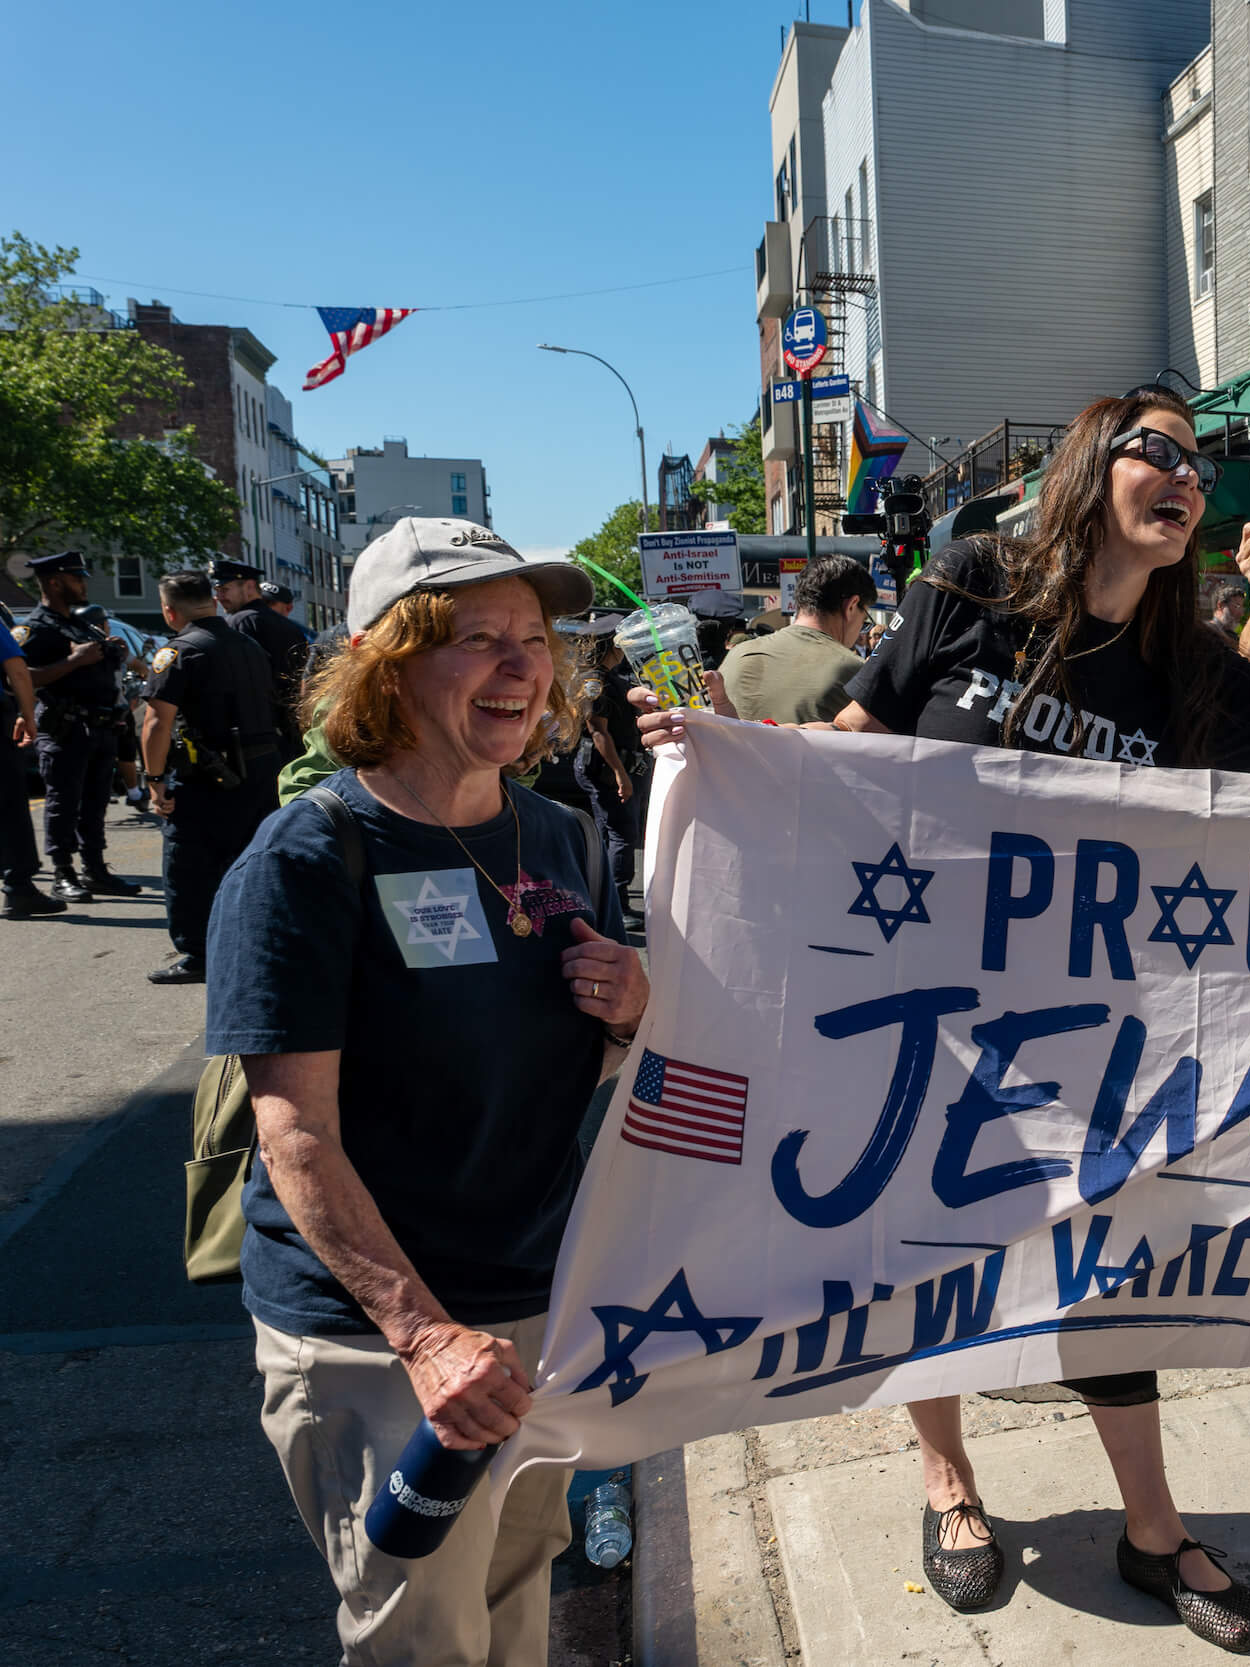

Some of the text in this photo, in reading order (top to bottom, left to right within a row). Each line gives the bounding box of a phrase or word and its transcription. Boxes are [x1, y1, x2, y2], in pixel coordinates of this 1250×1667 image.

[785, 352, 796, 365] NO
[775, 384, 794, 401] B48
[663, 549, 718, 560] Anti-Israel
[674, 560, 709, 571] Is NOT
[656, 571, 730, 584] Anti-Semitism
[419, 911, 464, 922] STRONGER
